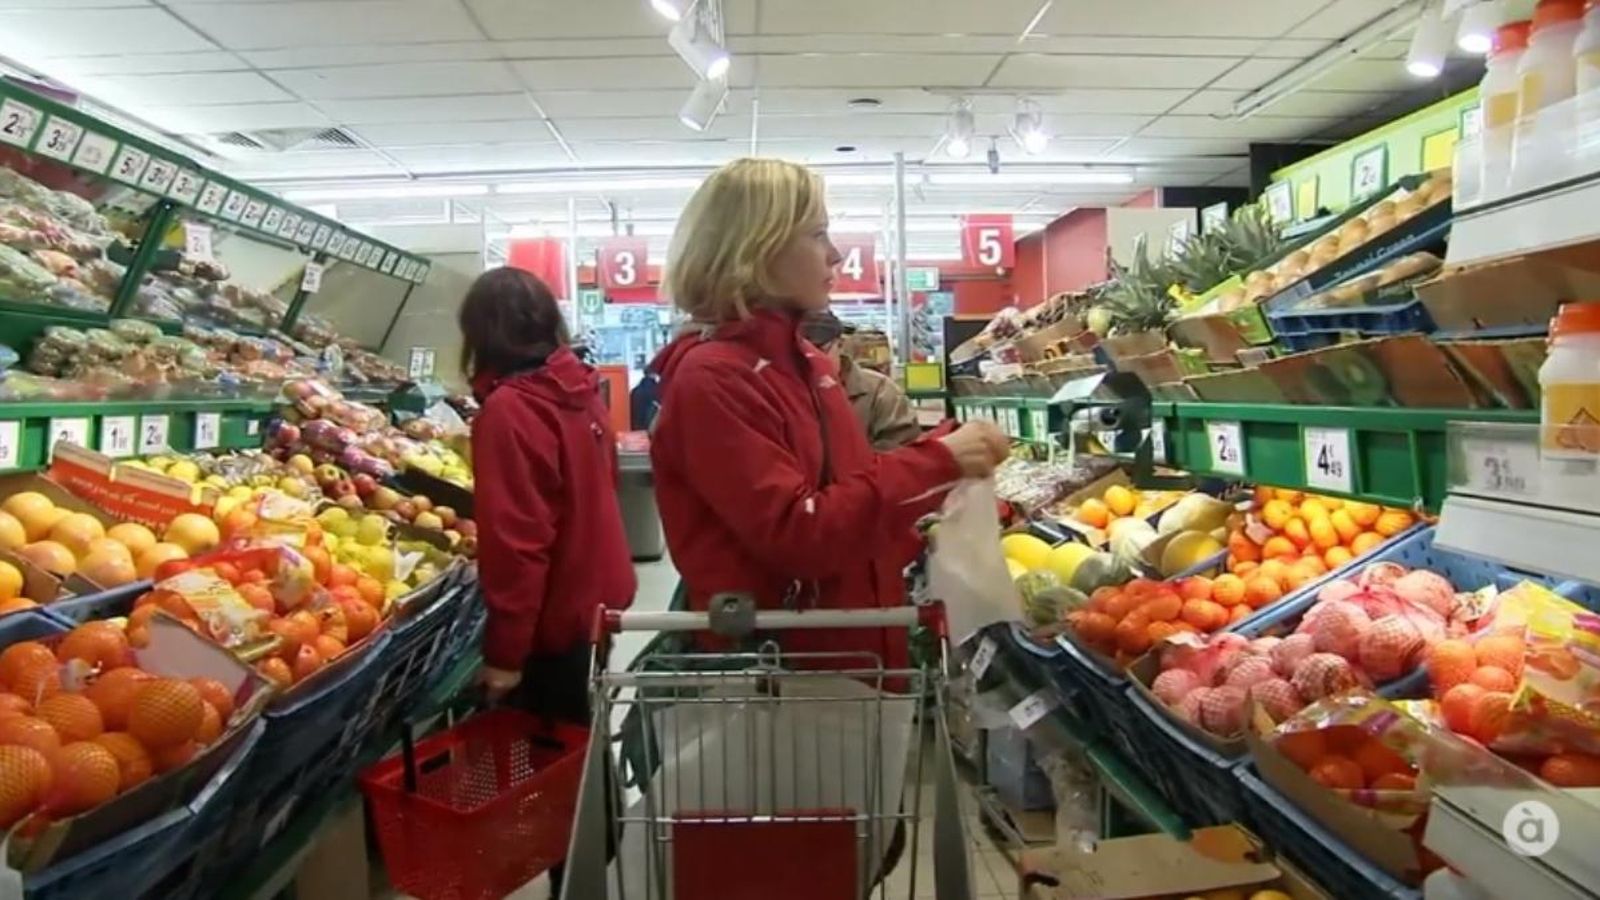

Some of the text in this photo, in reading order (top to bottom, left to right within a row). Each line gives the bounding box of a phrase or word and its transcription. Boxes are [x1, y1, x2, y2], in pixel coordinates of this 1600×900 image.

[841, 247, 863, 280] 4
[978, 229, 1003, 265] 5
[614, 251, 636, 285] 3
[1317, 444, 1330, 476] 4
